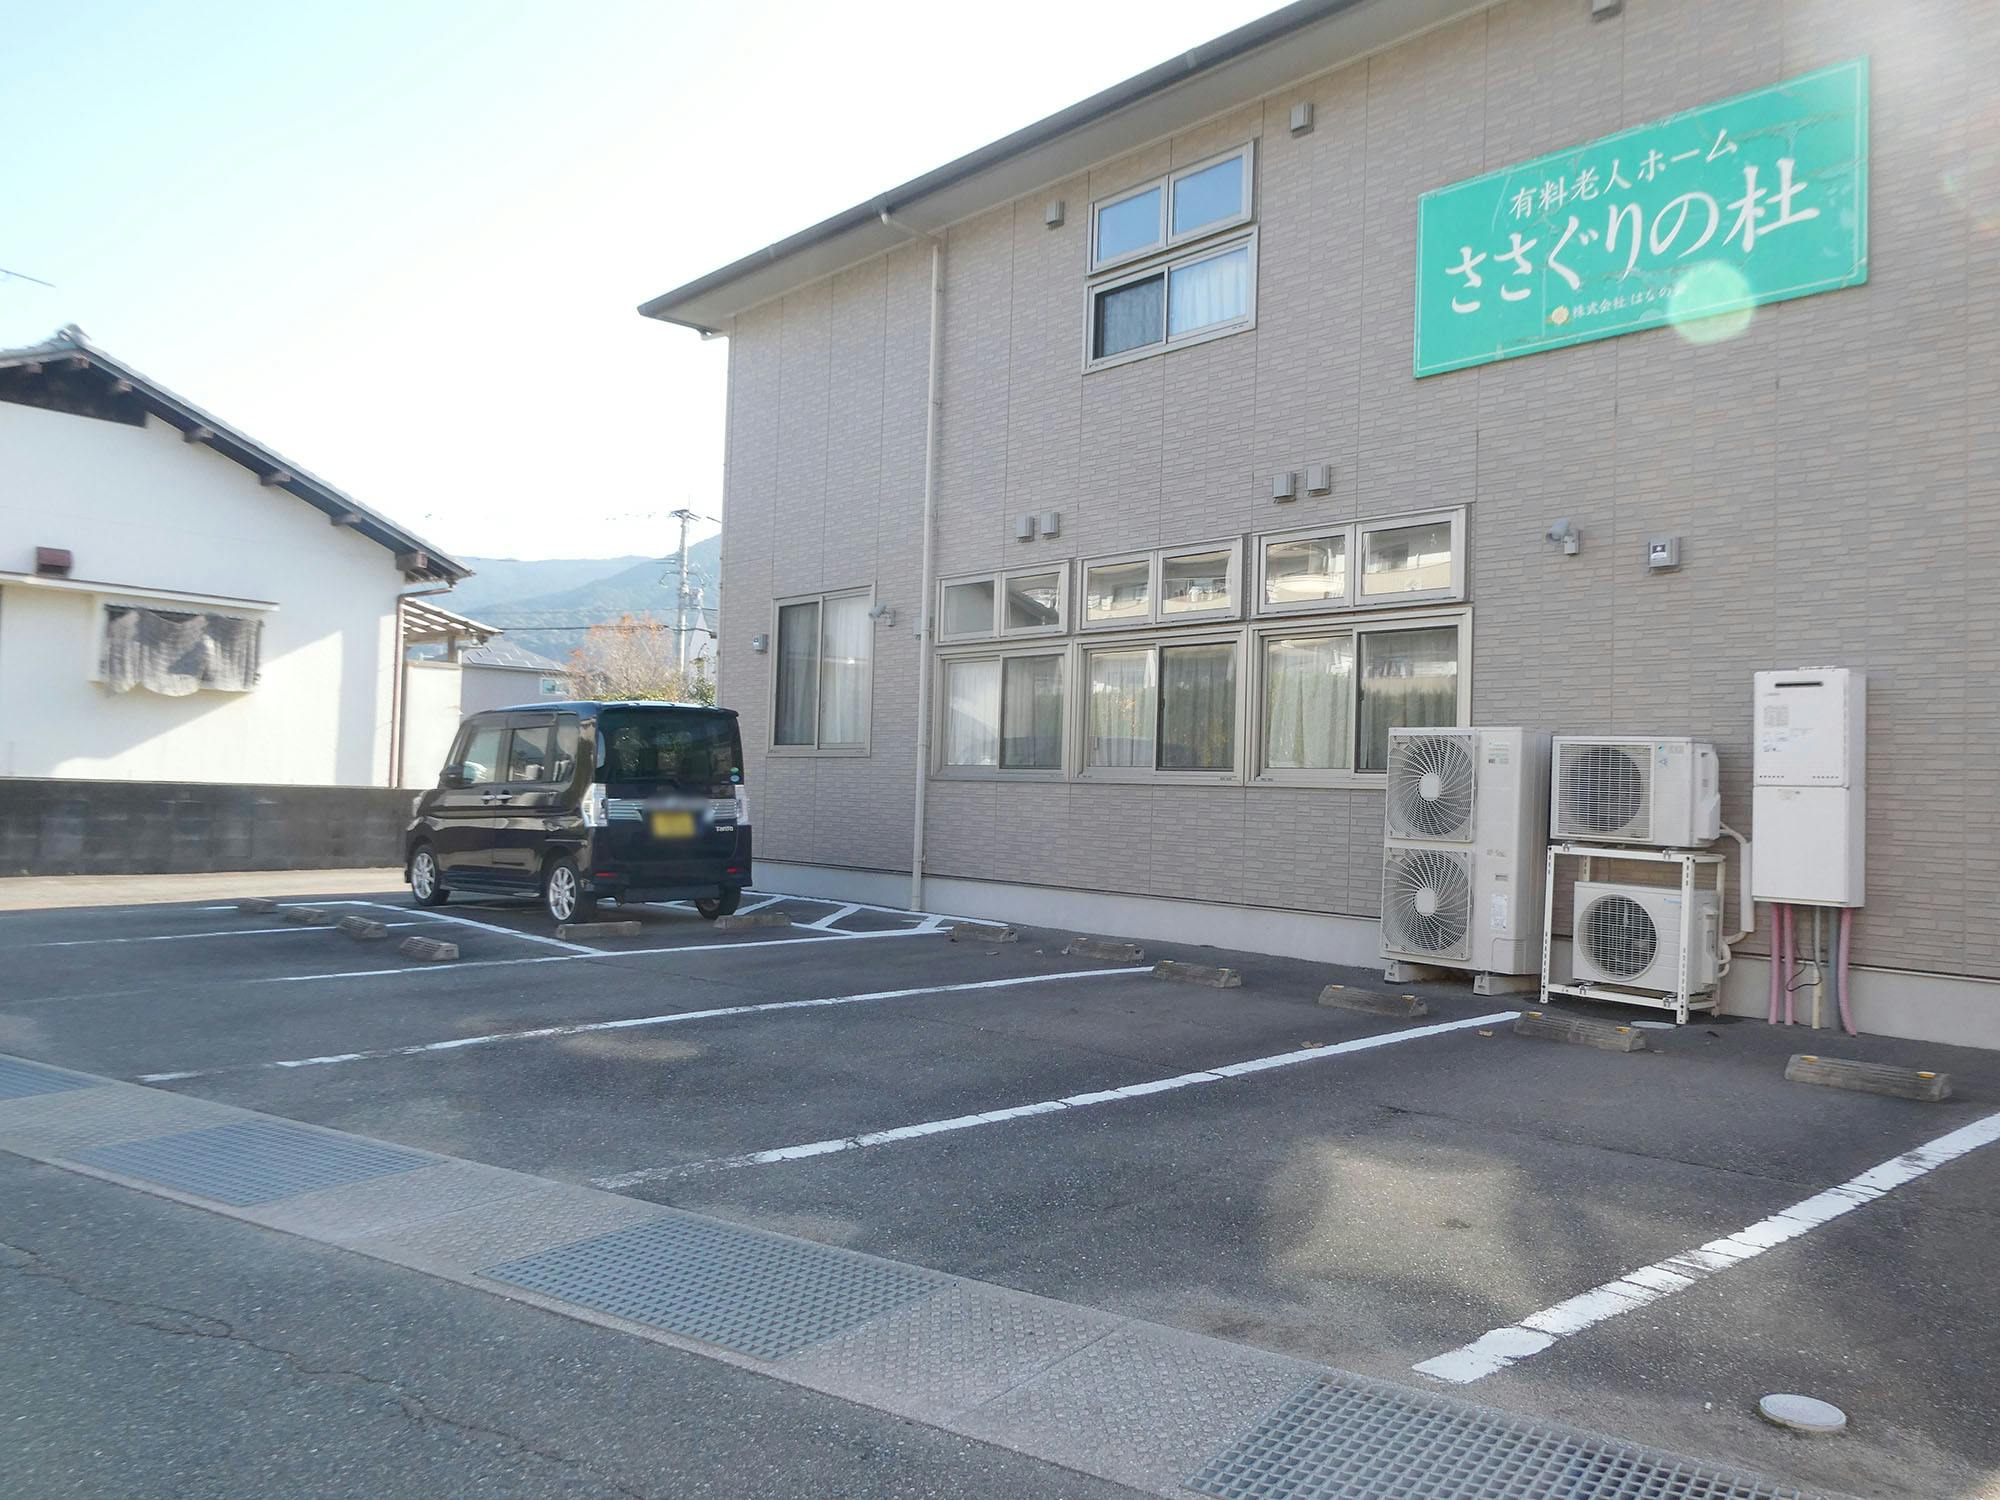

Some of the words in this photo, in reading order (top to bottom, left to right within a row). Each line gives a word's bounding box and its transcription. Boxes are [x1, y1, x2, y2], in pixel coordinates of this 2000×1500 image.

[1445, 158, 1820, 313] ささぐりの杜
[1509, 129, 1737, 220] 有料老人ホーム
